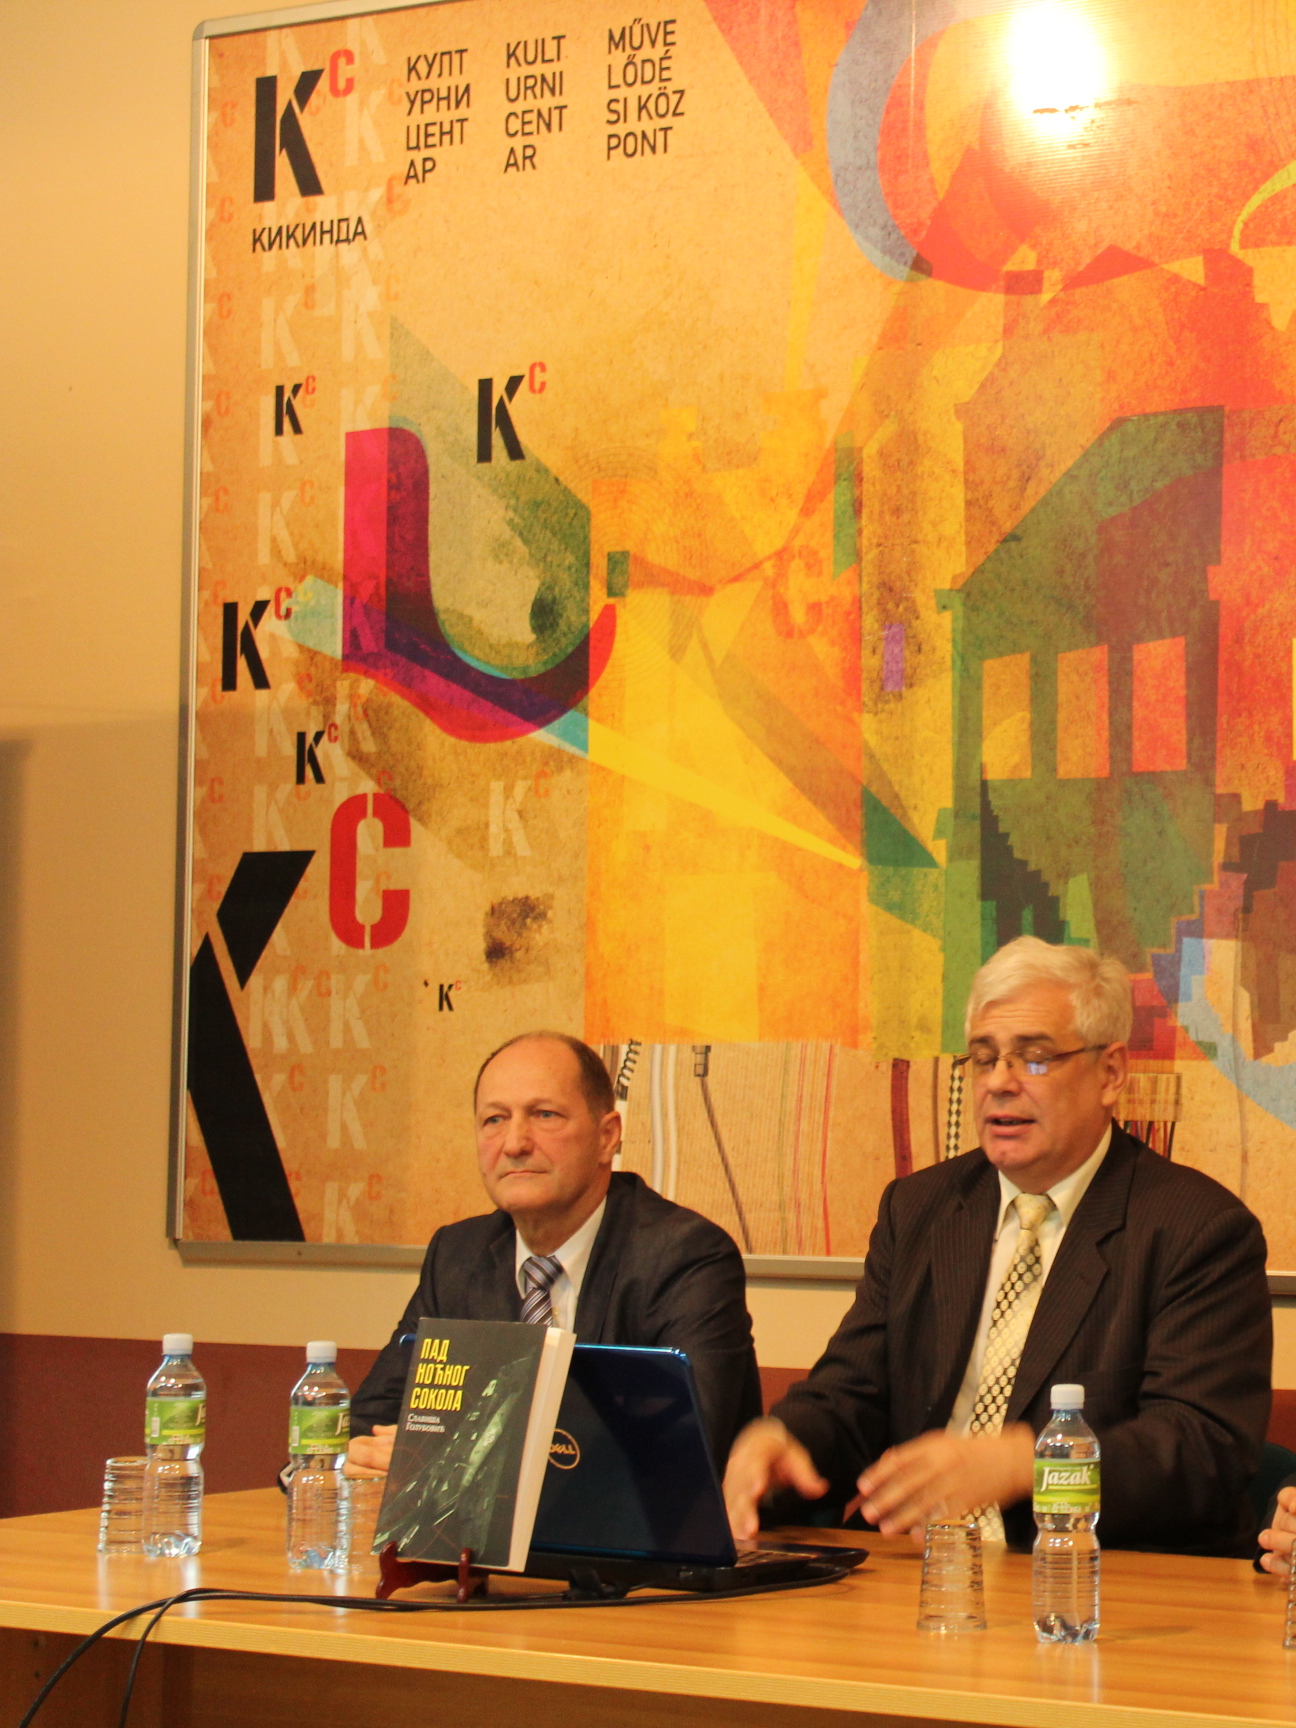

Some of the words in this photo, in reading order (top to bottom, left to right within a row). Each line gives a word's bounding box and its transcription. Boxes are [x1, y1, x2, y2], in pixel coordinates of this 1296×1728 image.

[505, 35, 567, 69] KULT
[607, 18, 678, 55] MŰVE
[405, 48, 469, 83] КУЛТ
[606, 50, 673, 90] LŐDÉ
[404, 83, 471, 117] УРНИ
[504, 70, 564, 103] URNI
[504, 105, 568, 137] CENT
[605, 102, 629, 126] SI
[637, 90, 686, 119] KÖZ
[404, 118, 469, 152] ЦЕНТ
[606, 126, 674, 161] PONT
[403, 157, 437, 186] АР
[503, 145, 537, 174] AR
[251, 216, 368, 254] КИКИНДА
[420, 1338, 450, 1363] ПАД
[414, 1362, 471, 1387] НОЋНОГ
[409, 1387, 463, 1411] СОКОЛА
[1040, 1465, 1092, 1492] Jazak
